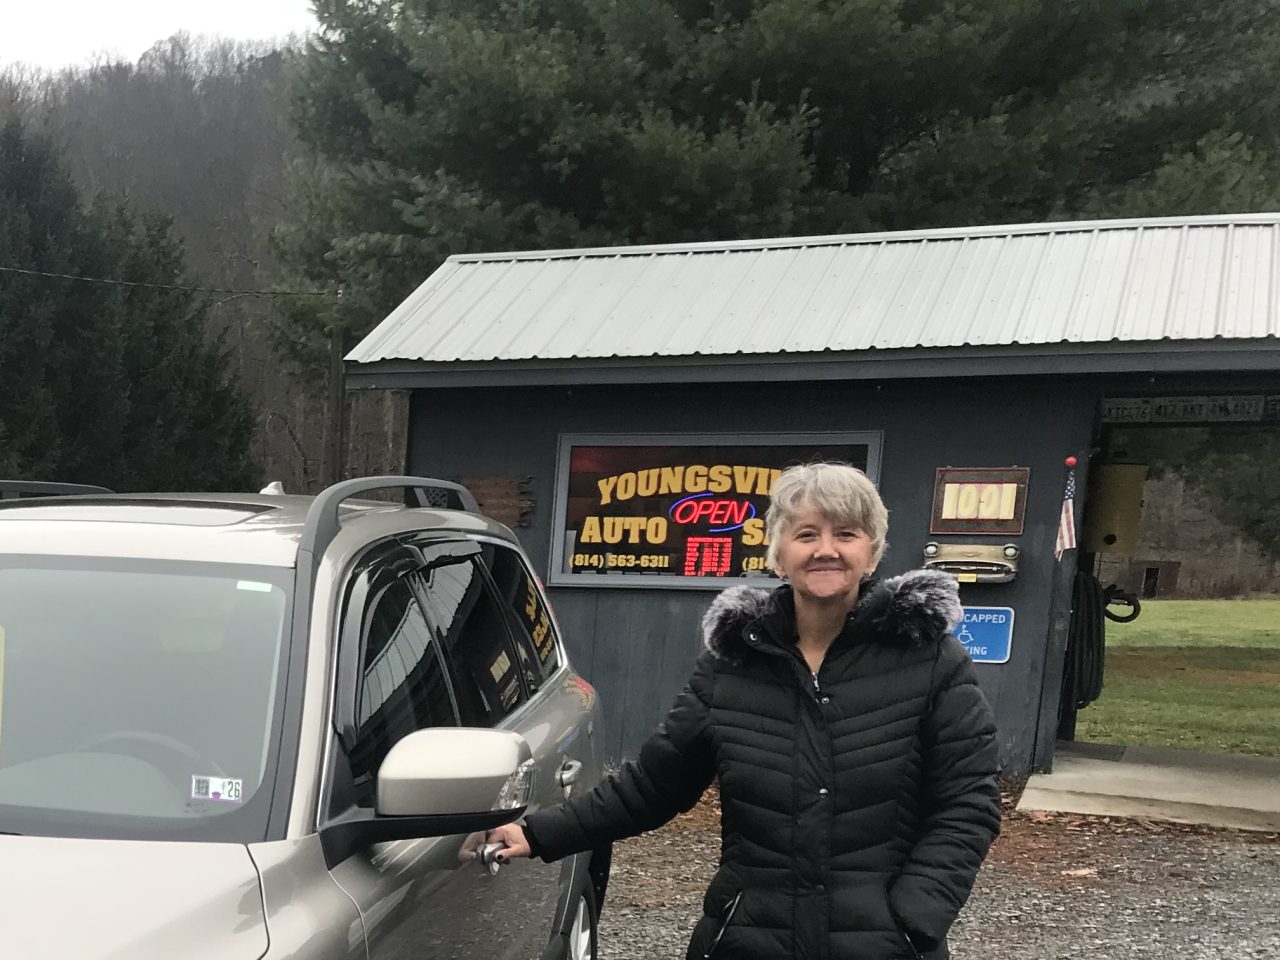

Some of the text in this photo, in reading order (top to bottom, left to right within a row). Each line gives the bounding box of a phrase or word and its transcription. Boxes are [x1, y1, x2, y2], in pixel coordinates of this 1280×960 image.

[675, 500, 749, 524] OPEN
[580, 517, 769, 546] AUTO S
[569, 554, 669, 568] (814) 563-6311
[963, 613, 1006, 624] CAPPED
[228, 780, 241, 798] 26
